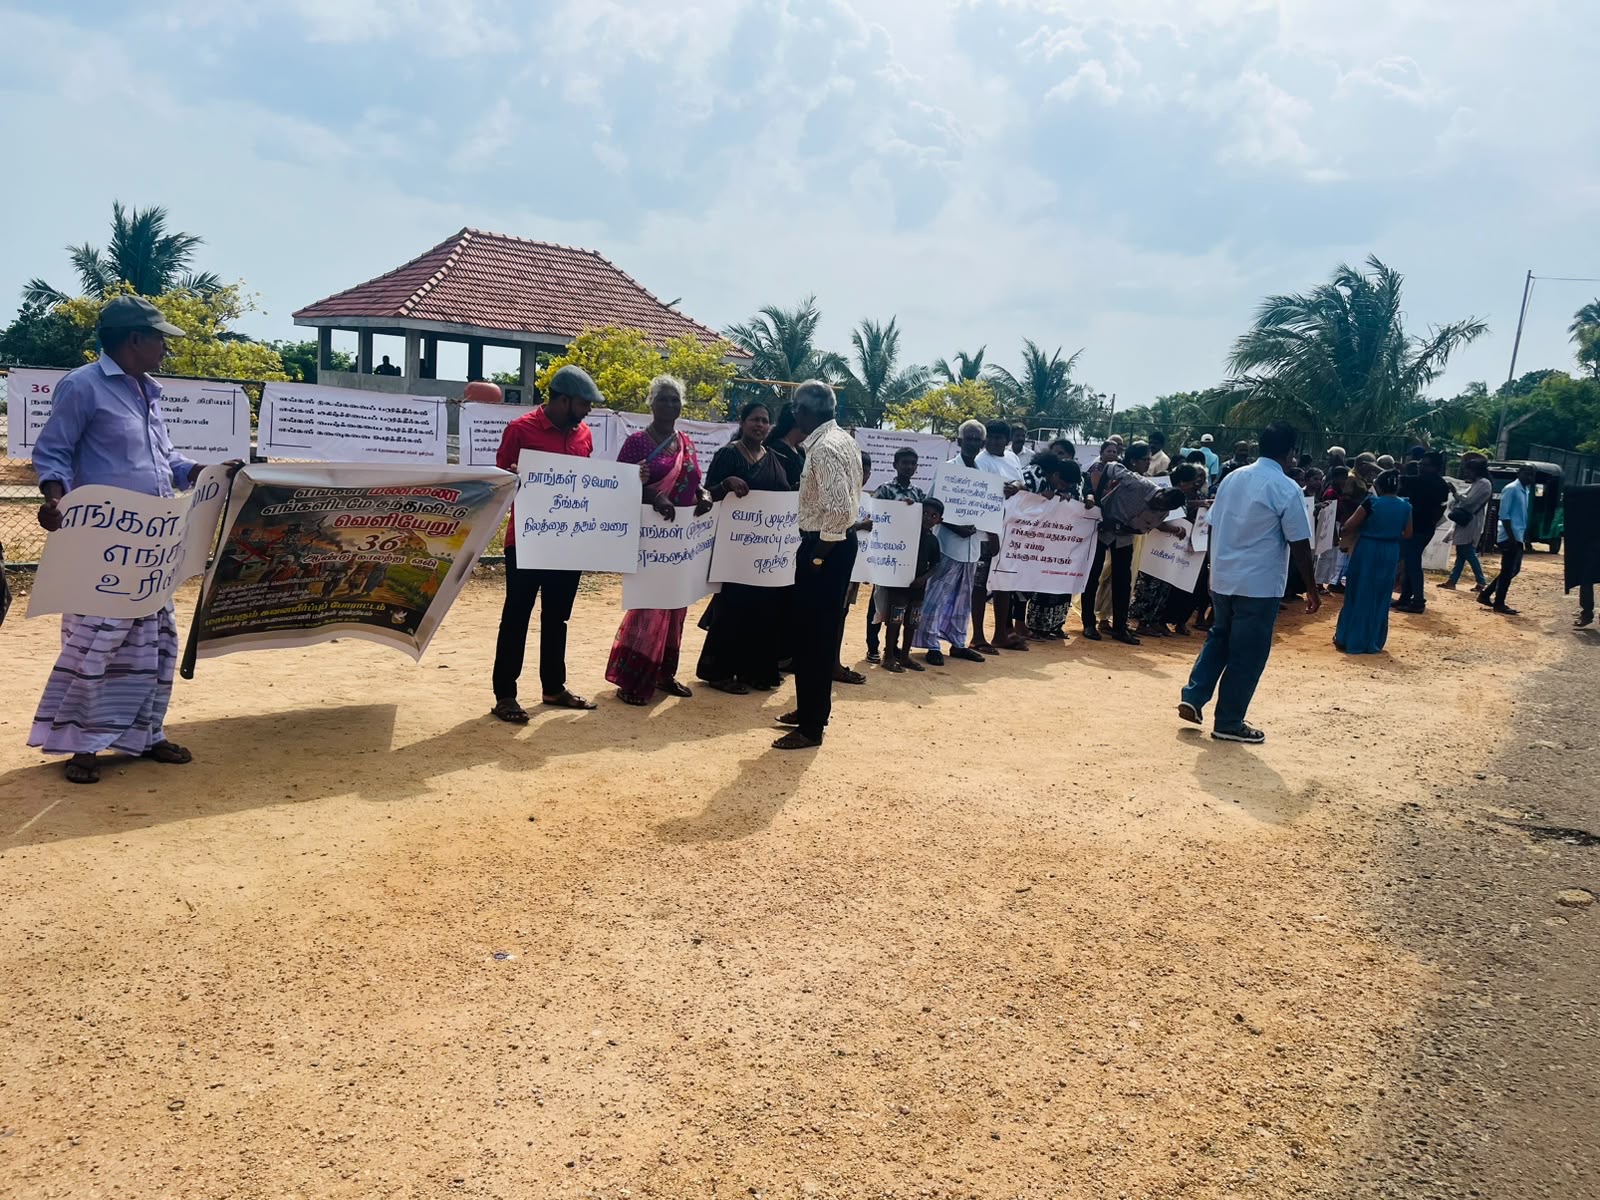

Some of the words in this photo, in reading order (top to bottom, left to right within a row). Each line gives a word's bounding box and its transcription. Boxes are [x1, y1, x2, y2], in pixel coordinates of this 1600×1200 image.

[31, 384, 50, 394] 36
[524, 467, 577, 493] நாங்கள்
[549, 494, 589, 513] நீங்கள்
[61, 501, 180, 538] எங்கள்
[334, 513, 461, 536] வெளியேறு!
[523, 517, 568, 537] நிலத்தை
[570, 518, 597, 537] தரும்
[600, 521, 629, 537] வரை
[731, 509, 763, 527] போர்
[358, 534, 403, 551] 36
[730, 531, 782, 553] பாதுகாப்பு
